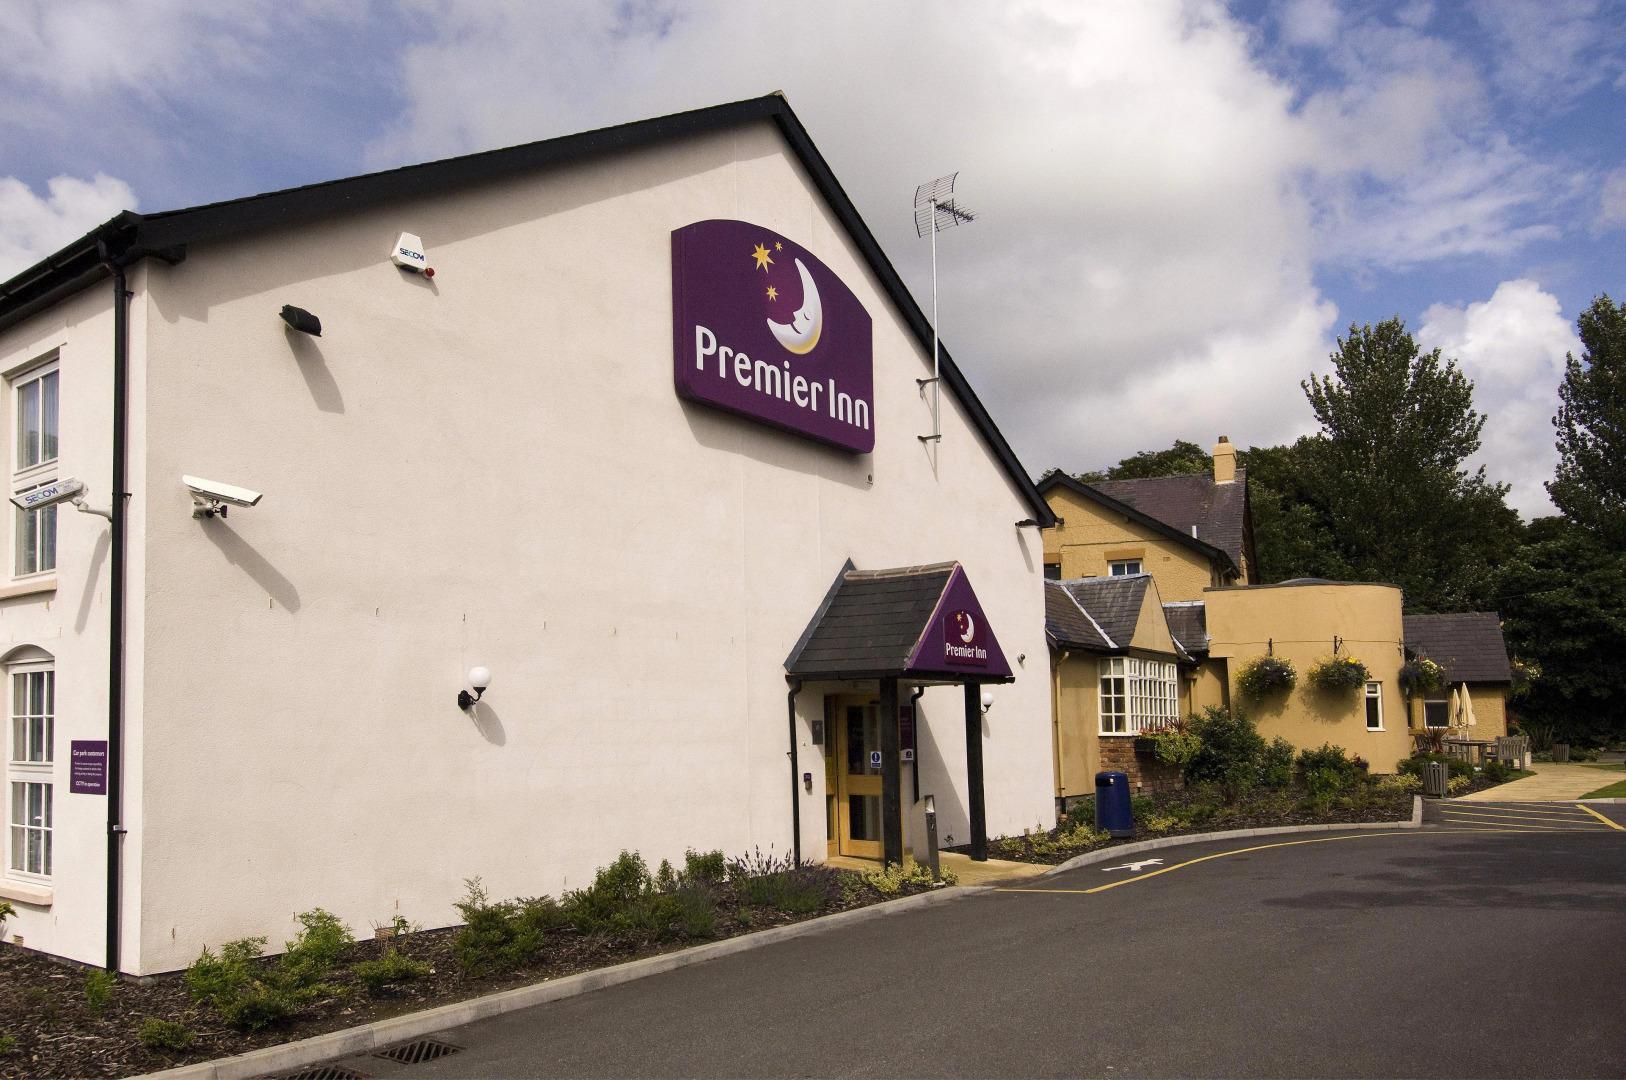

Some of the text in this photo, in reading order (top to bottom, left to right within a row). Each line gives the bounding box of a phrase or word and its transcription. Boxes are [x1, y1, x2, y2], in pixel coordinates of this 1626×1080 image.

[400, 247, 425, 261] SECOM
[695, 324, 870, 430] Premier Inn
[25, 487, 59, 504] SECOM
[945, 642, 987, 660] Premier Inn
